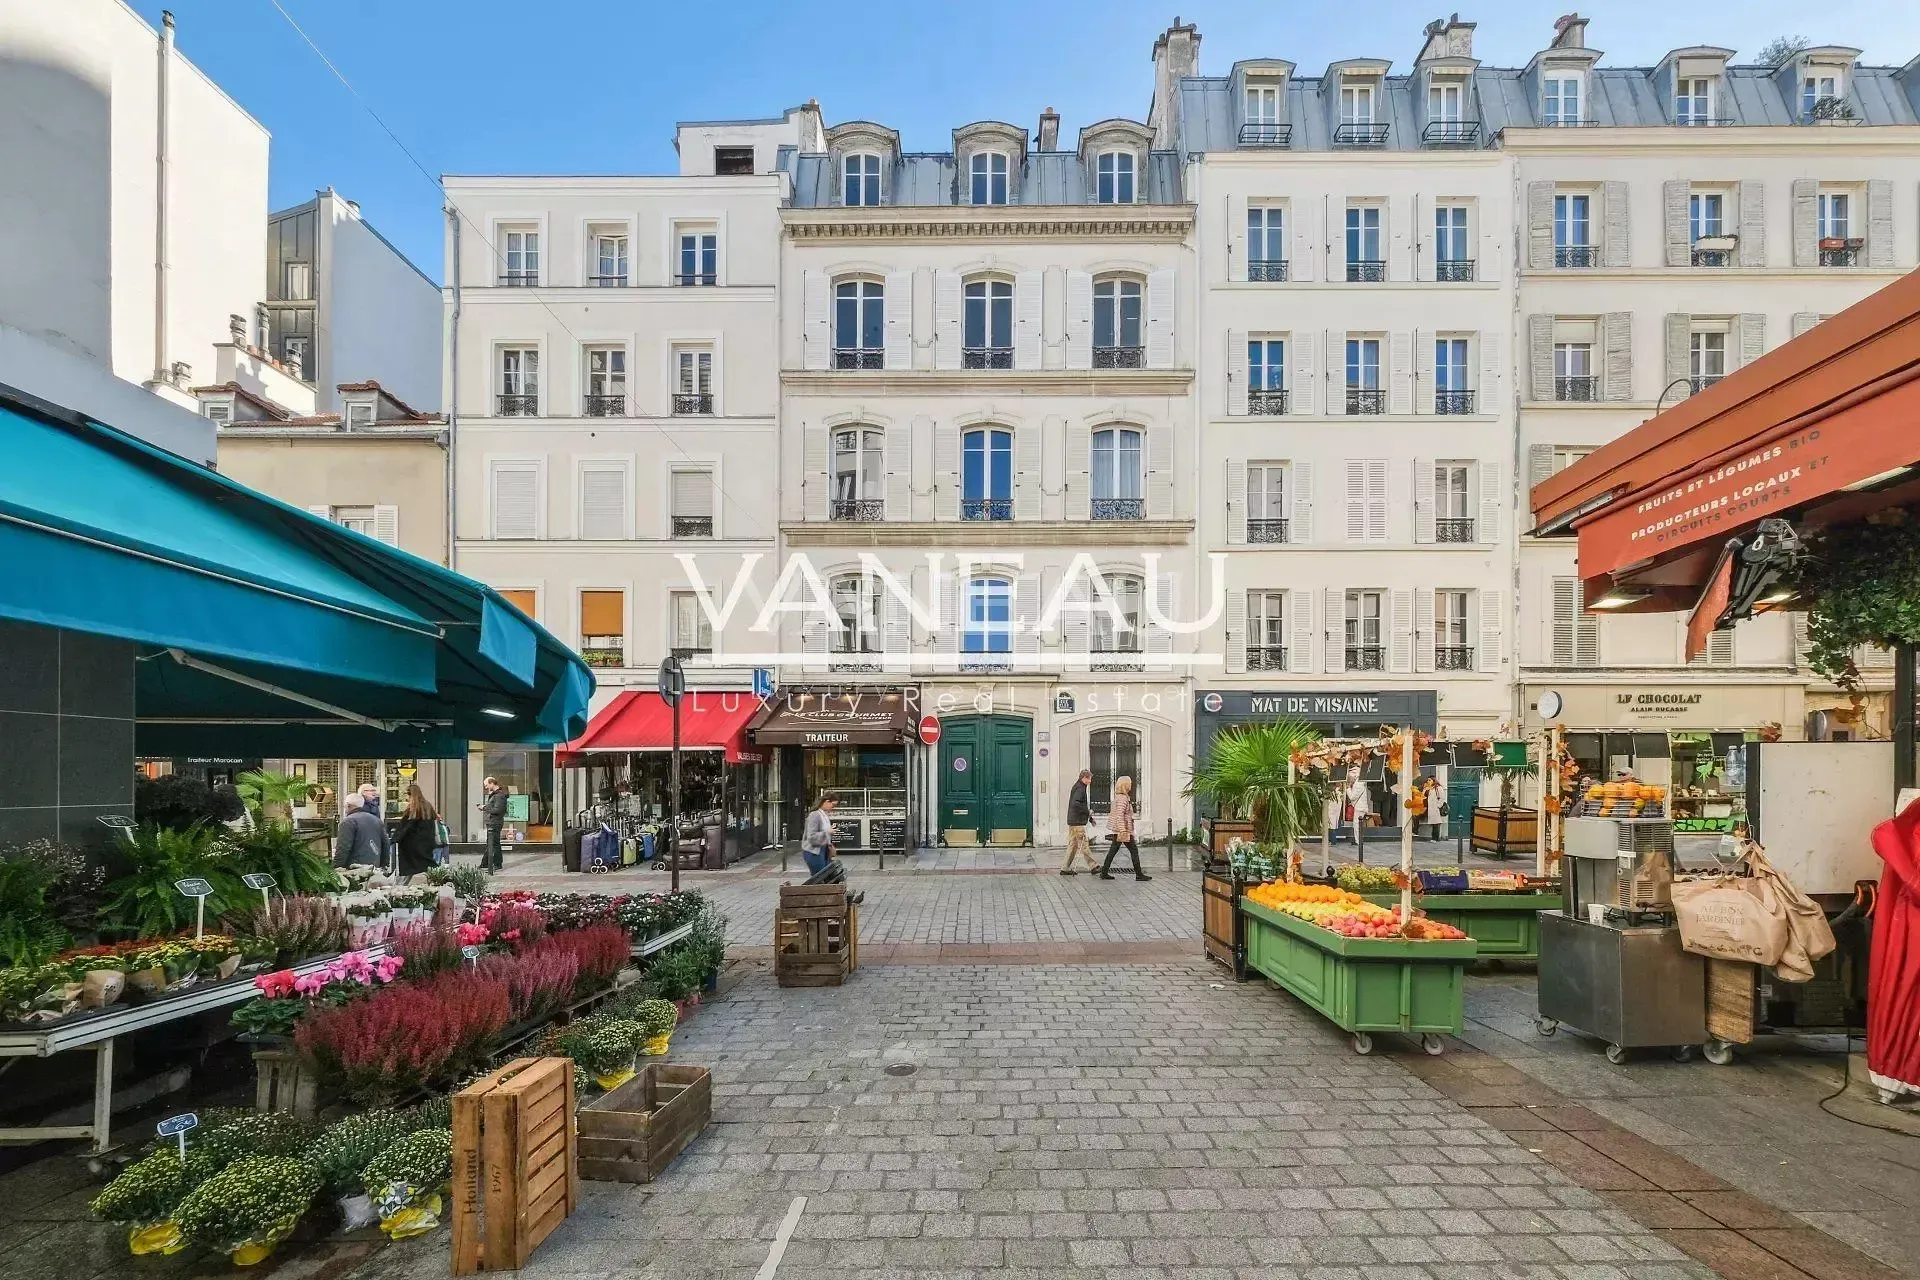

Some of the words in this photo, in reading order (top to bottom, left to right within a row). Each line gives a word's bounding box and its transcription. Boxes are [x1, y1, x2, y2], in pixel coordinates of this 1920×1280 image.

[1638, 489, 1683, 514] FRUITS
[1687, 479, 1704, 493] ET
[1708, 446, 1782, 484] LÉGUMES
[1788, 430, 1820, 449] BIO
[1631, 496, 1728, 541] PRODUCTEURS
[1733, 467, 1801, 501] LOCAUX
[1808, 455, 1829, 470] ET
[1657, 512, 1721, 542] CIRCUITS
[1727, 487, 1792, 517] COURTS
[1251, 697, 1282, 713] MAT
[1287, 697, 1309, 713] DE
[1314, 697, 1379, 713] MISAINE
[1637, 694, 1702, 704] CHOCOLAT
[805, 733, 849, 742] TRAITEUR
[464, 1149, 477, 1214] Holland
[491, 1164, 502, 1193] 1967
